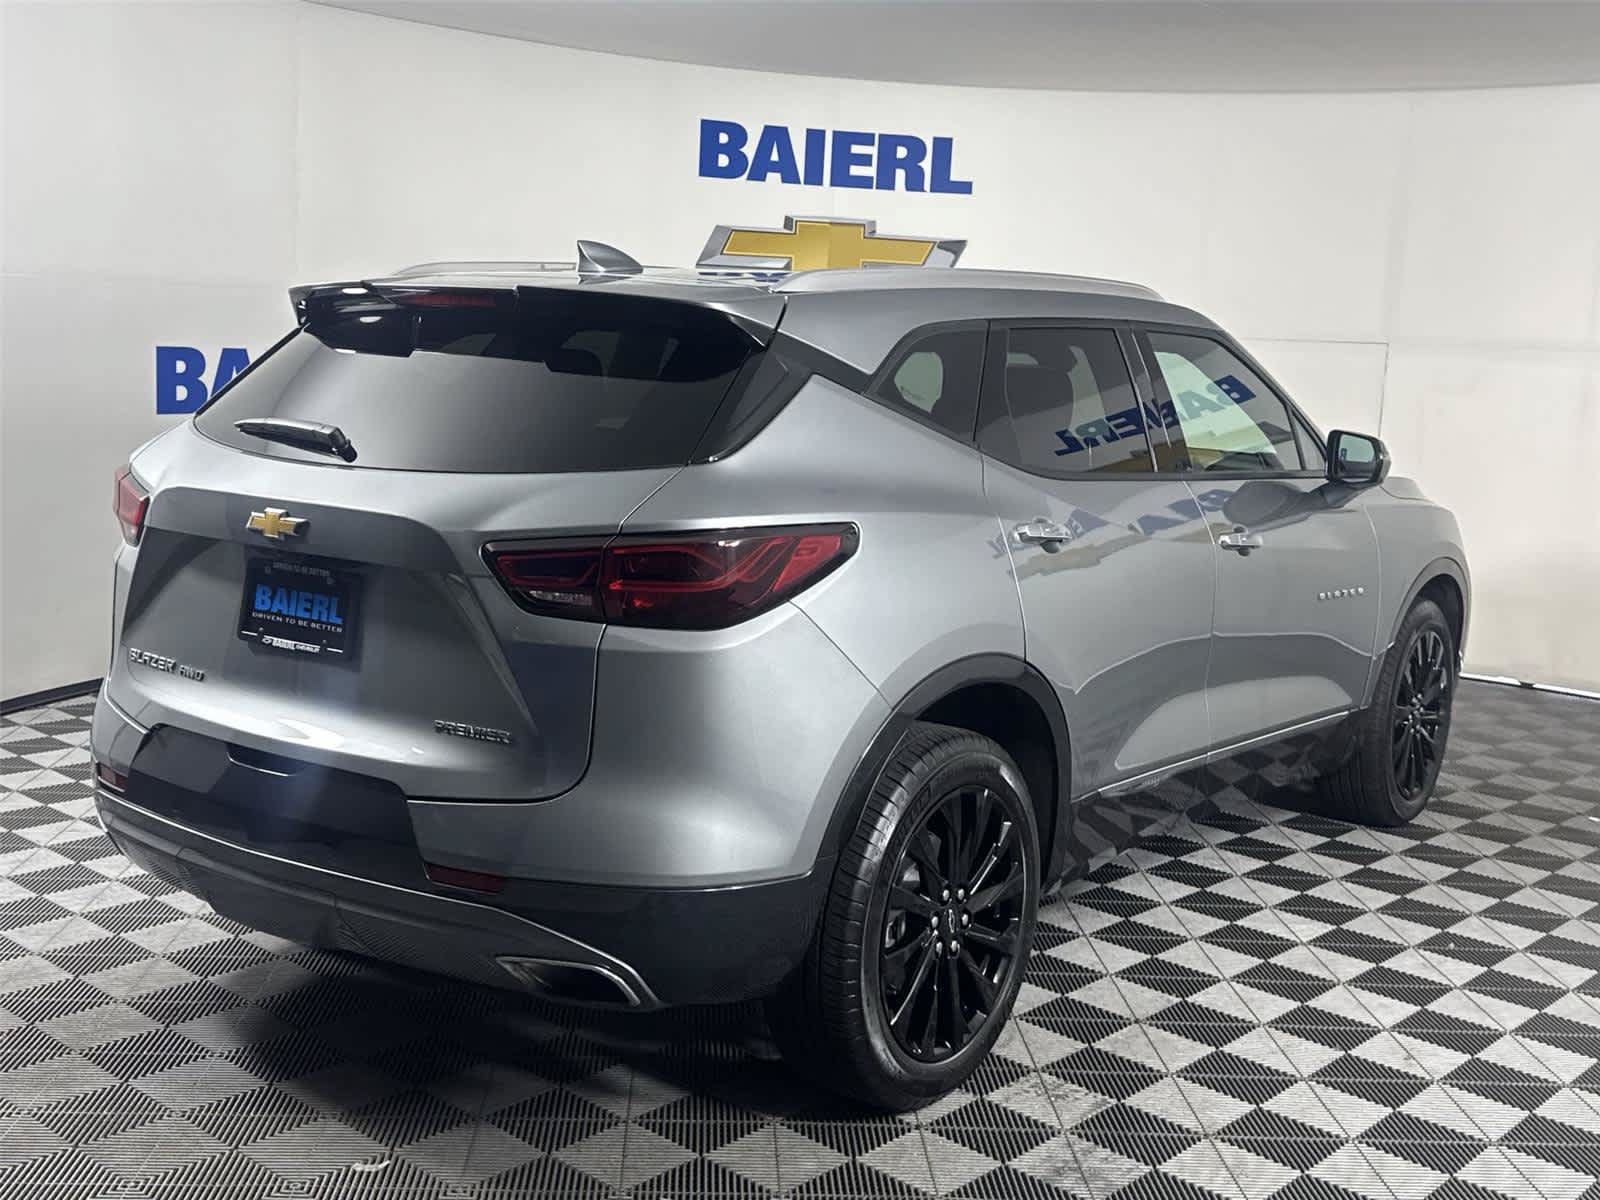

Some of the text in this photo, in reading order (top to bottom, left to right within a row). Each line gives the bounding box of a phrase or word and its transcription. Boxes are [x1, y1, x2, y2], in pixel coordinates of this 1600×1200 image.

[699, 118, 973, 194] BAIERL
[255, 583, 344, 625] BAIERL
[252, 611, 343, 633] DRIVEN TO BE BETTER
[129, 647, 176, 673] BLAZER
[434, 719, 511, 744] PREMIER
